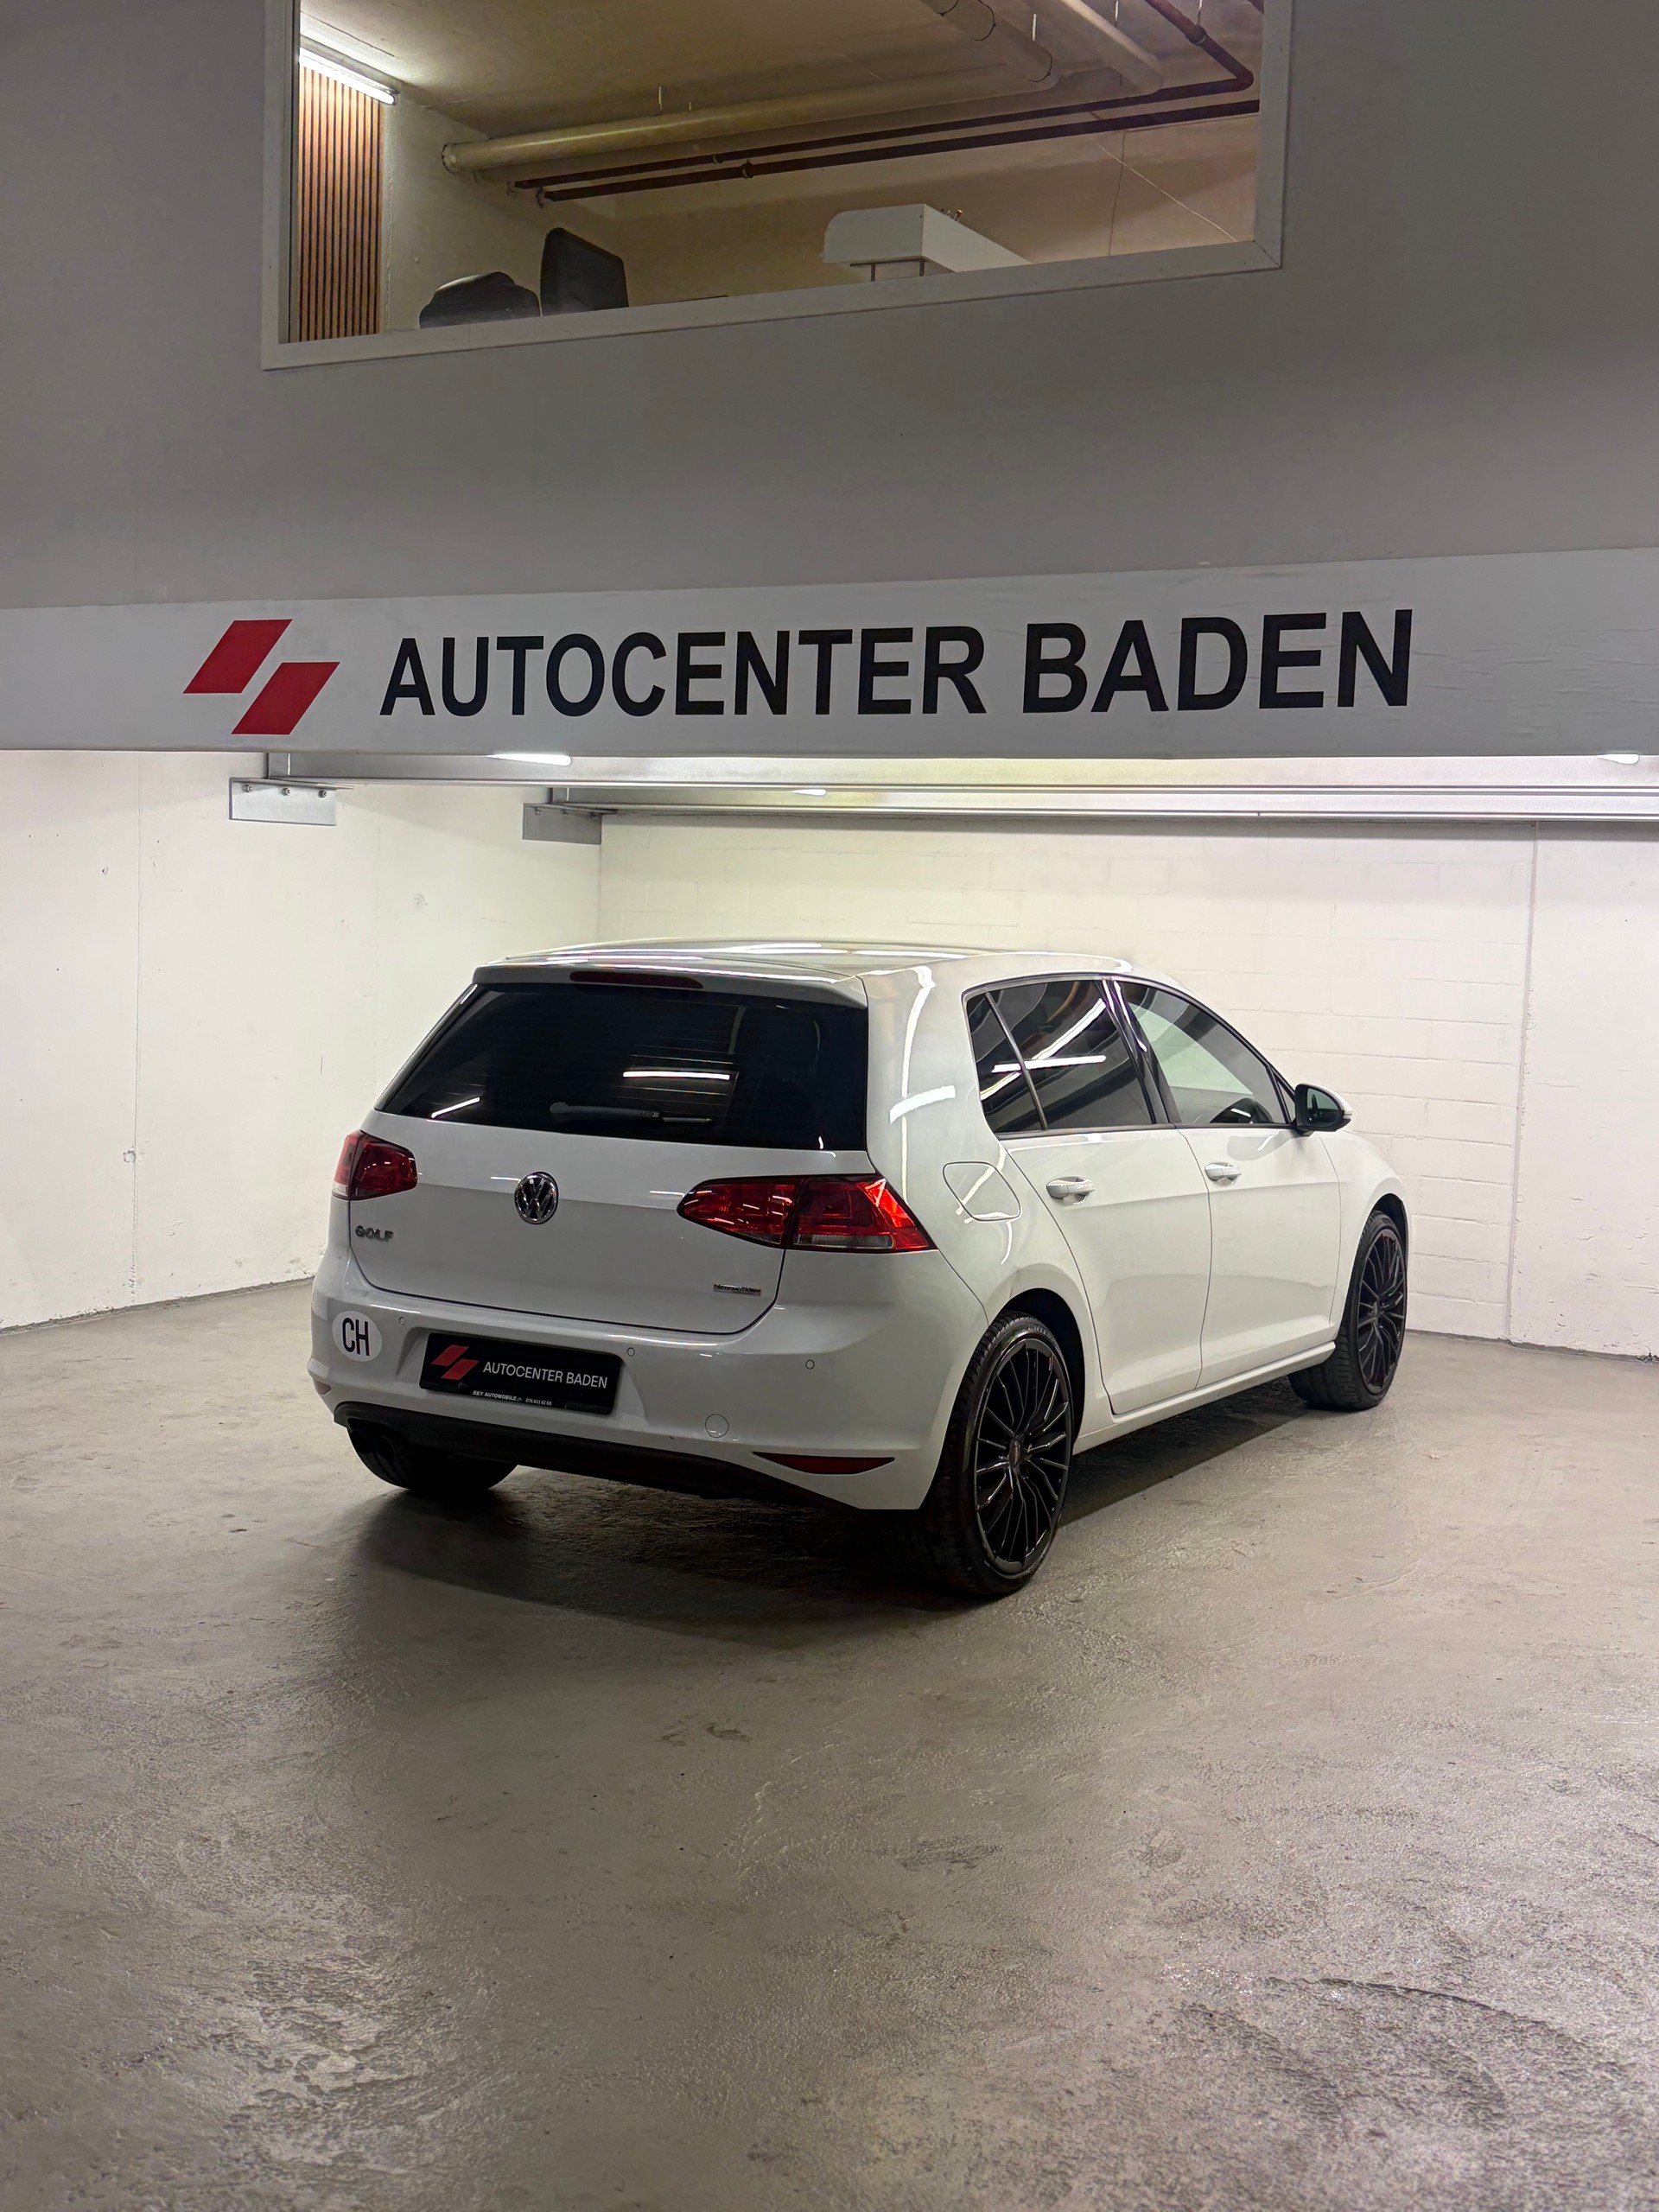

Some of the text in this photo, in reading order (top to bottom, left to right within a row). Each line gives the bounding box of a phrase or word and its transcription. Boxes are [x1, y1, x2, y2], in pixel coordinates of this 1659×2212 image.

[379, 608, 1413, 717] AUTOCENTER BADEN
[355, 1224, 394, 1243] GOLF
[342, 1317, 370, 1357] CH
[482, 1361, 608, 1389] AUTOCENTER BADEN
